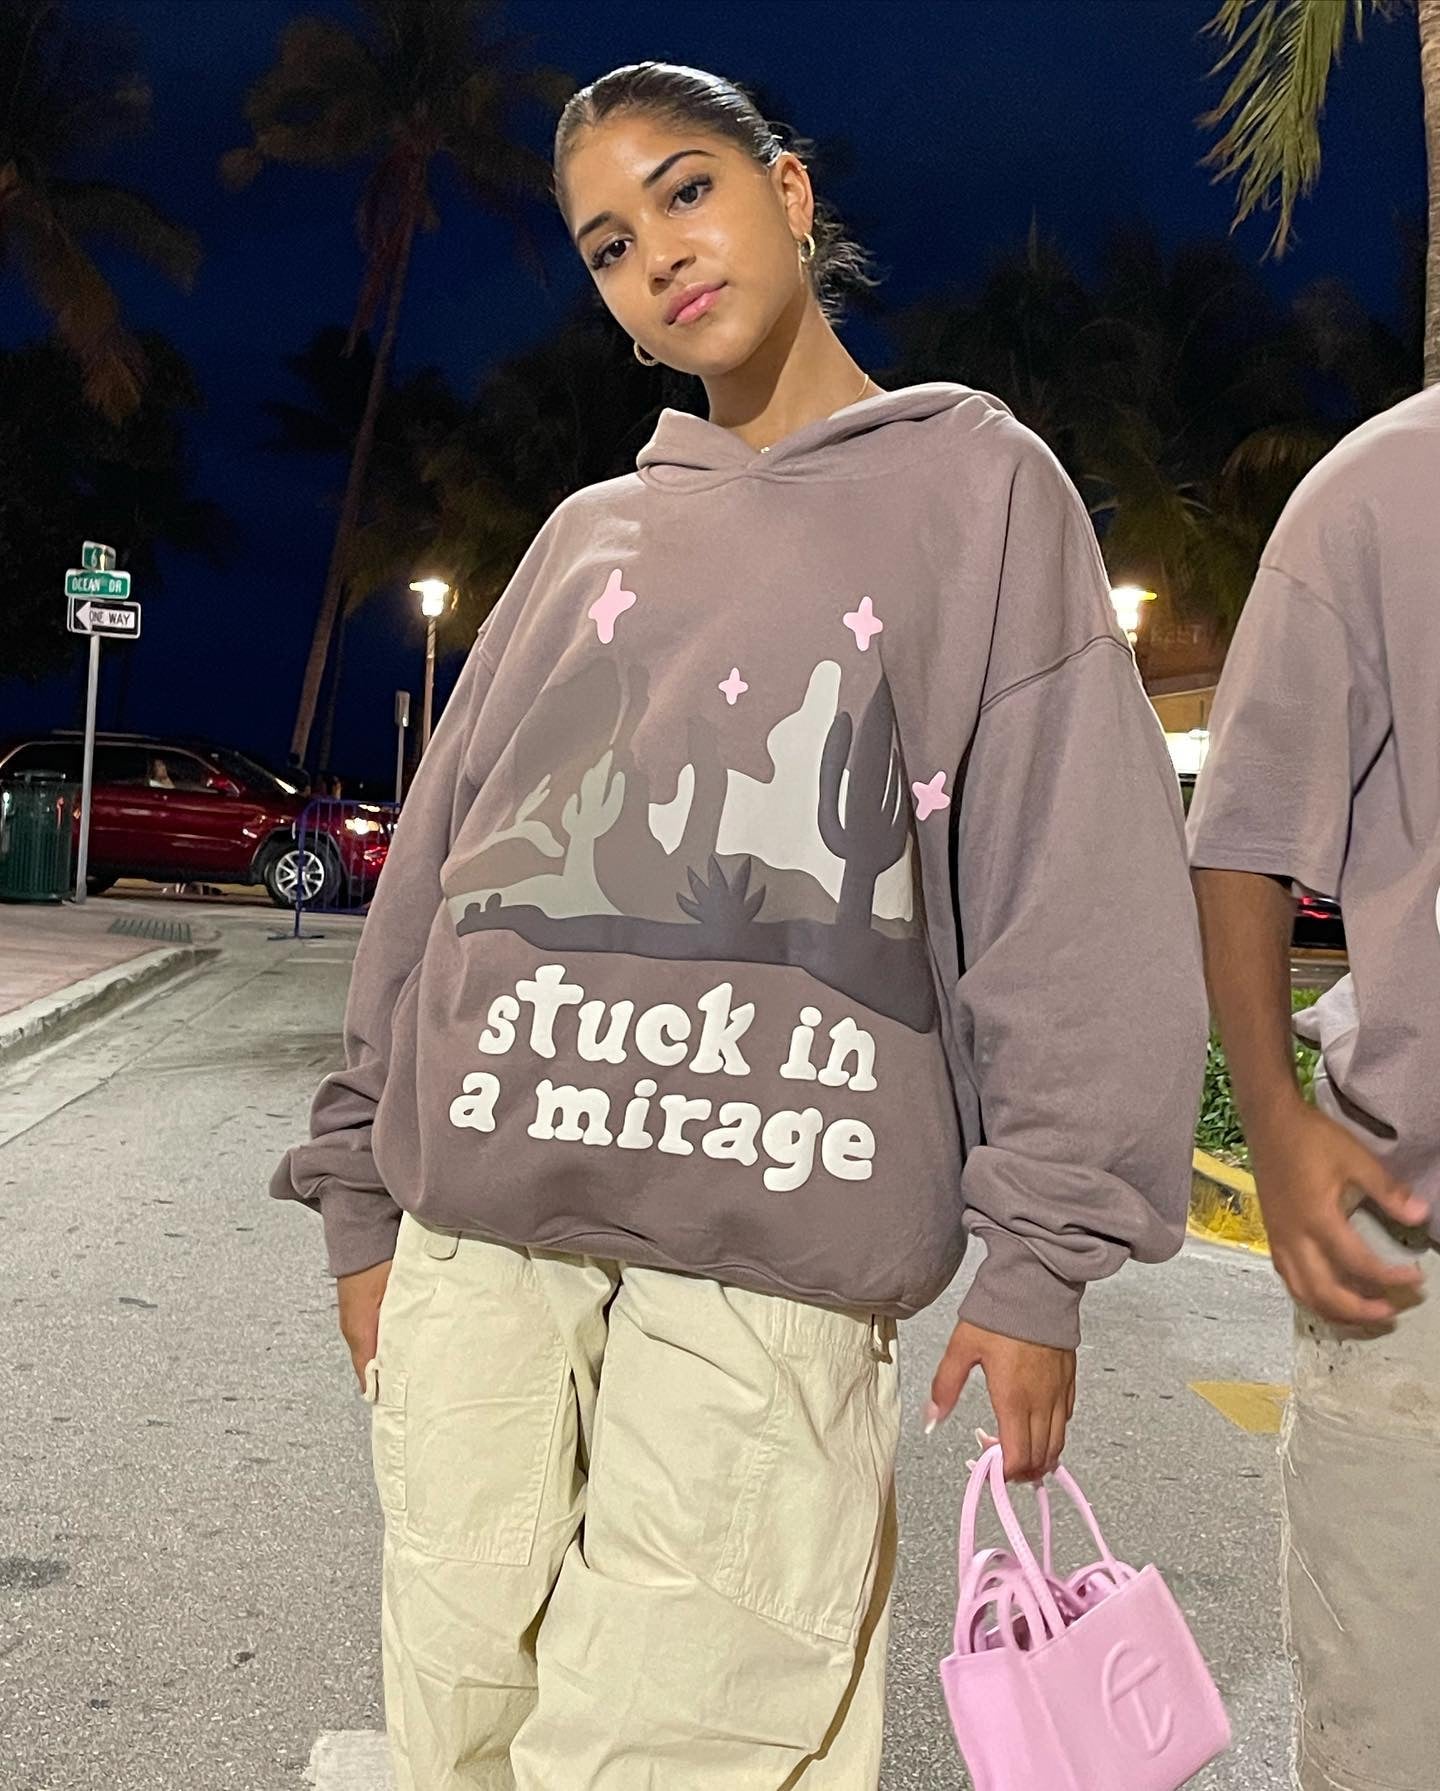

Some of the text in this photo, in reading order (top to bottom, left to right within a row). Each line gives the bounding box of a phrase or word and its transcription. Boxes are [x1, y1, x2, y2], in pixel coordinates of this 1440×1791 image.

[71, 577, 122, 593] OCEAN DR
[89, 610, 131, 625] ONE WAY
[478, 964, 878, 1092] stuck in
[449, 1072, 876, 1192] a mirage
